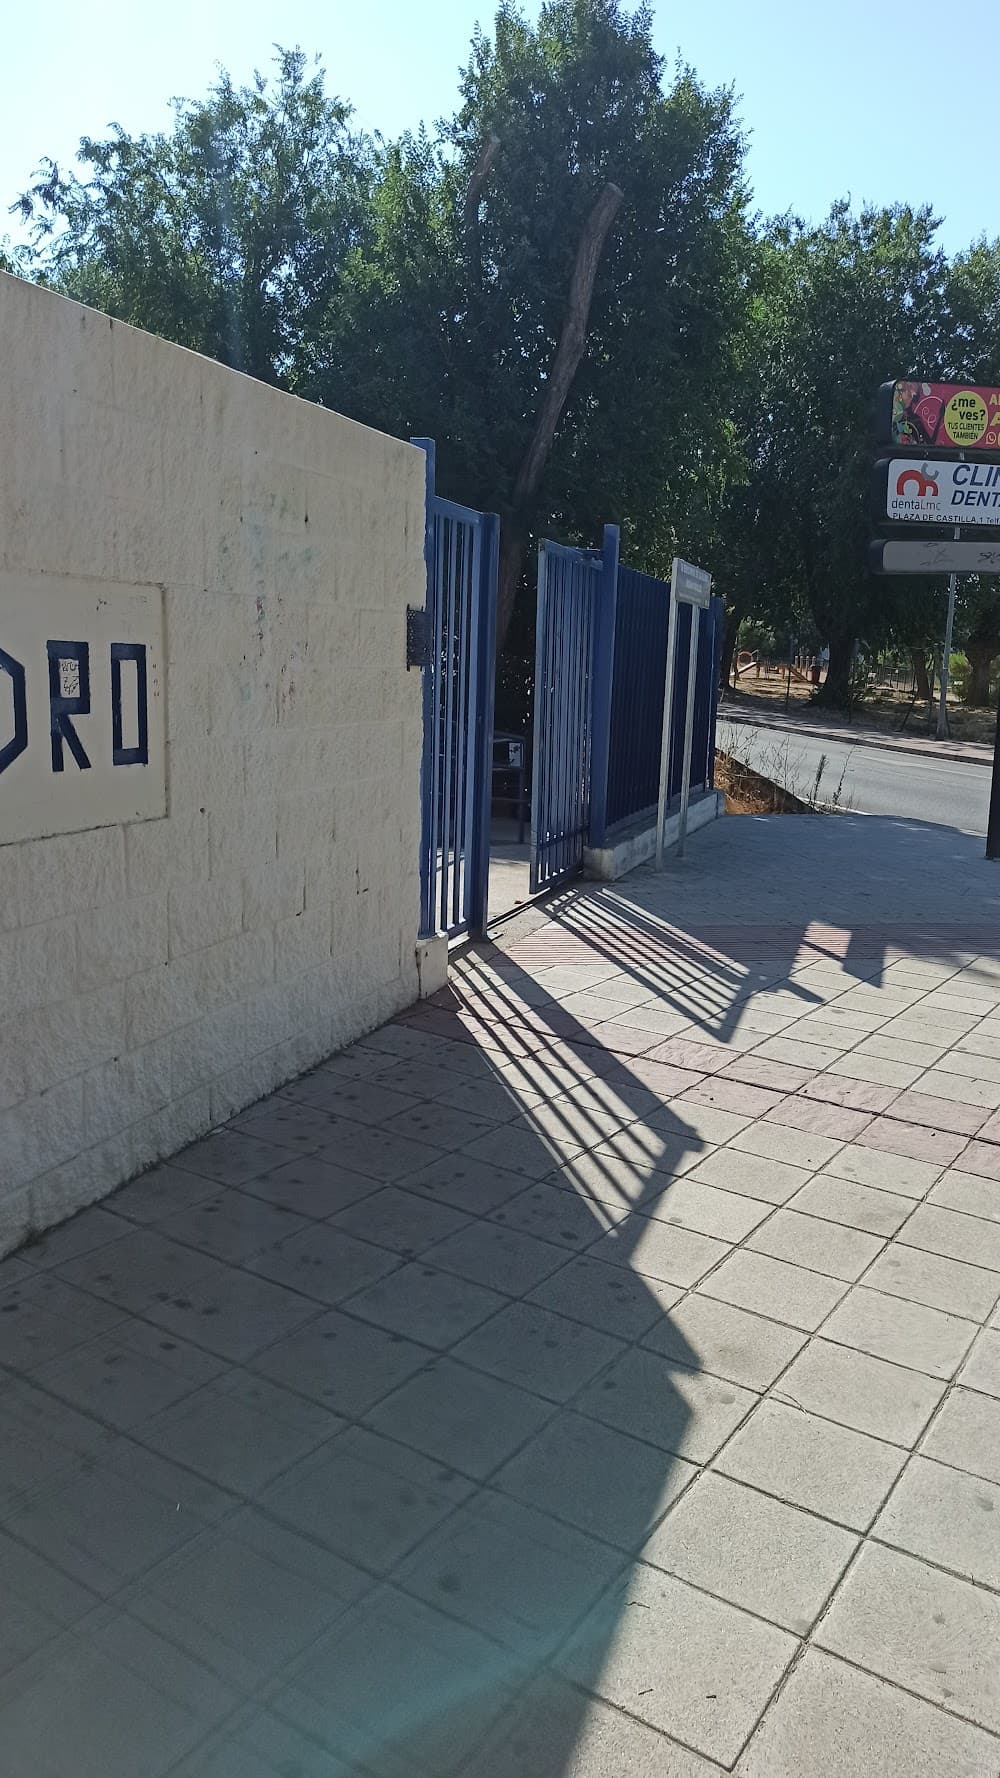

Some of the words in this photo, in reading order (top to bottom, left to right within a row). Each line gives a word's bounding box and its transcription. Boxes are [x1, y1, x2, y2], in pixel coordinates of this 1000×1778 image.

[951, 398, 976, 410] ¿me
[959, 409, 986, 421] ves?
[948, 422, 958, 430] TUS
[960, 422, 985, 431] CLIENTES
[950, 490, 1000, 508] DENT
[892, 513, 920, 521] PLAZA
